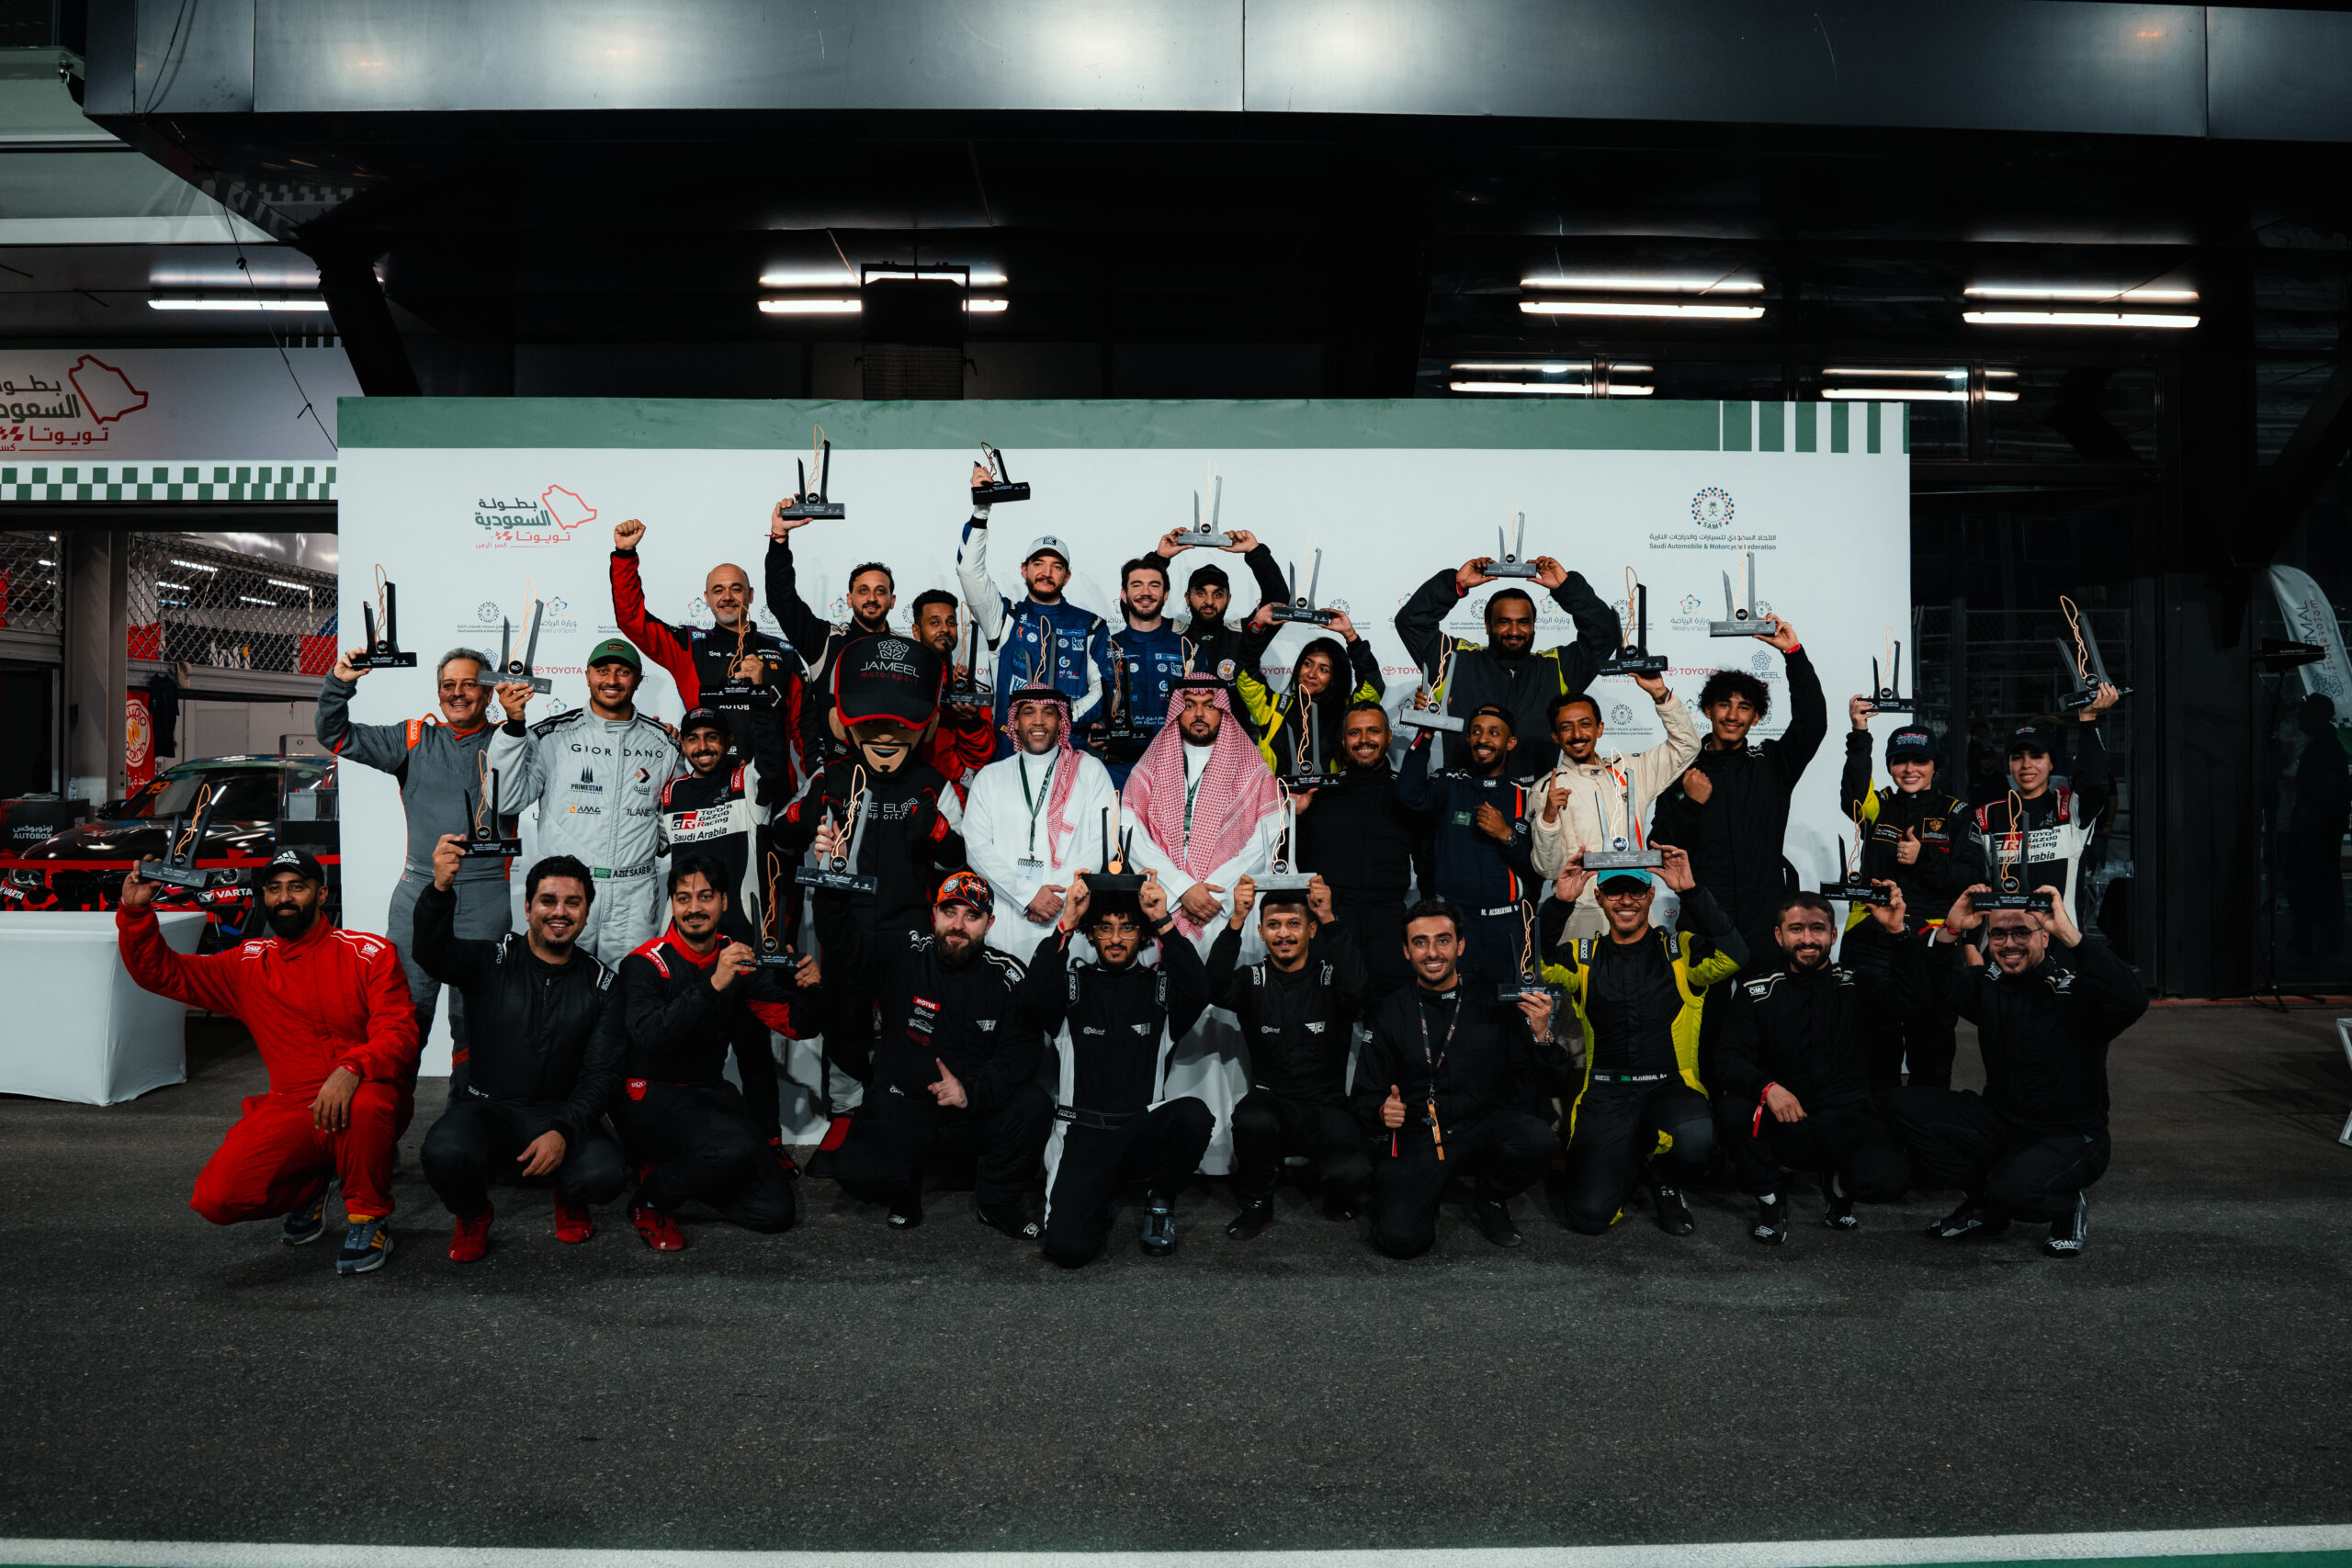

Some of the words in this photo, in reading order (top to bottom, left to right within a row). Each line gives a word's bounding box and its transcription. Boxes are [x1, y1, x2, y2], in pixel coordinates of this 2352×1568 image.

[0, 374, 62, 396] بطو
[0, 393, 82, 423] السعود
[29, 425, 109, 445] تويوتا
[479, 497, 538, 512] بطولة
[474, 510, 551, 530] السعودية
[1702, 521, 1724, 530] SAMF
[515, 531, 571, 544] تويوتا
[1709, 543, 1743, 552] Motorcycle
[539, 619, 559, 627] الرياض
[860, 661, 921, 678] JAMEEL
[1261, 667, 1293, 675] OYOTA
[718, 705, 751, 715] AUTOB
[145, 781, 171, 795] 19
[571, 784, 604, 792] PRIMESTAR
[699, 810, 729, 822] GAZOO
[700, 804, 733, 816] TOYOTA
[697, 817, 729, 828] Racing
[673, 833, 695, 843] Saudi
[697, 827, 727, 840] Arabia
[273, 856, 300, 865] adidas
[1998, 854, 2020, 863] audi
[3, 887, 26, 900] VARTA
[216, 887, 254, 899] VARTA
[363, 943, 379, 953] OMP
[1005, 967, 1022, 983] OMP
[1748, 985, 1767, 996] OMP
[916, 997, 936, 1010] MOTUL
